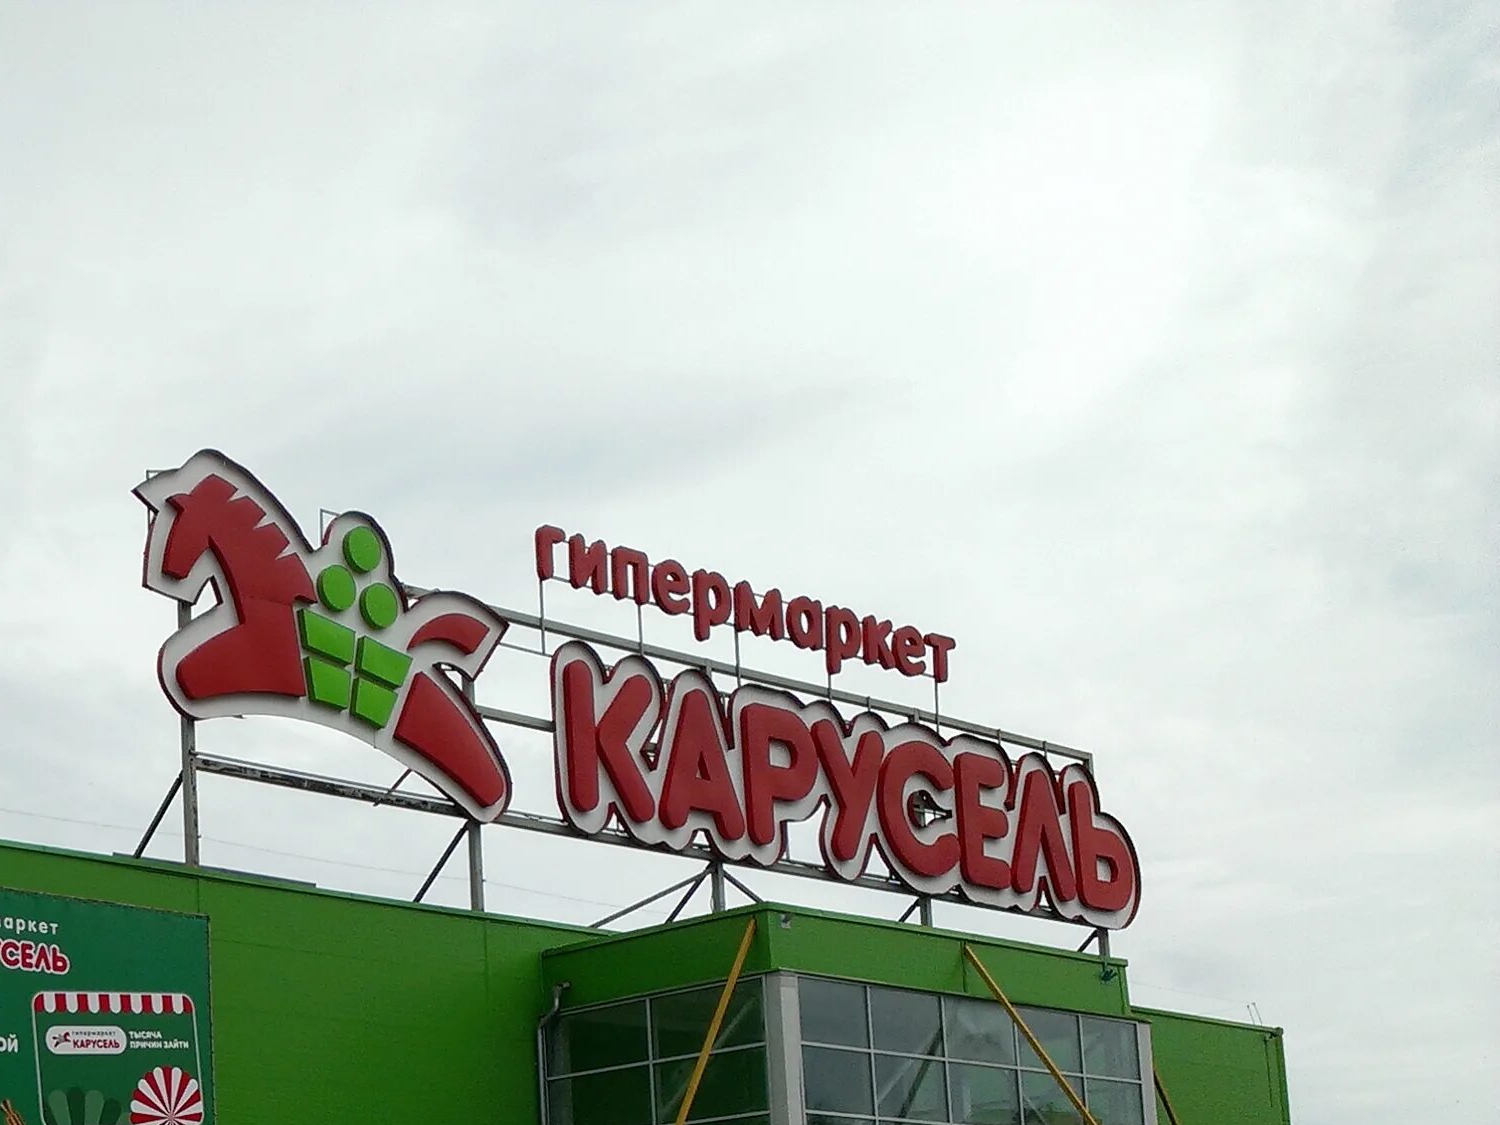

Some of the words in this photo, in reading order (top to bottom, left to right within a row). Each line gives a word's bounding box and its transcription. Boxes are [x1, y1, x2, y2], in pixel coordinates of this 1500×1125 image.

[534, 523, 957, 684] гипермаркет
[558, 652, 1138, 920] КАРУСЕЛЬ
[128, 1030, 163, 1040] ТЫСЯЧА
[72, 1039, 120, 1049] КАРУСЕЛЬ
[129, 1040, 163, 1049] ПРИЧИН
[163, 1038, 189, 1049] ЗАЙТИ
